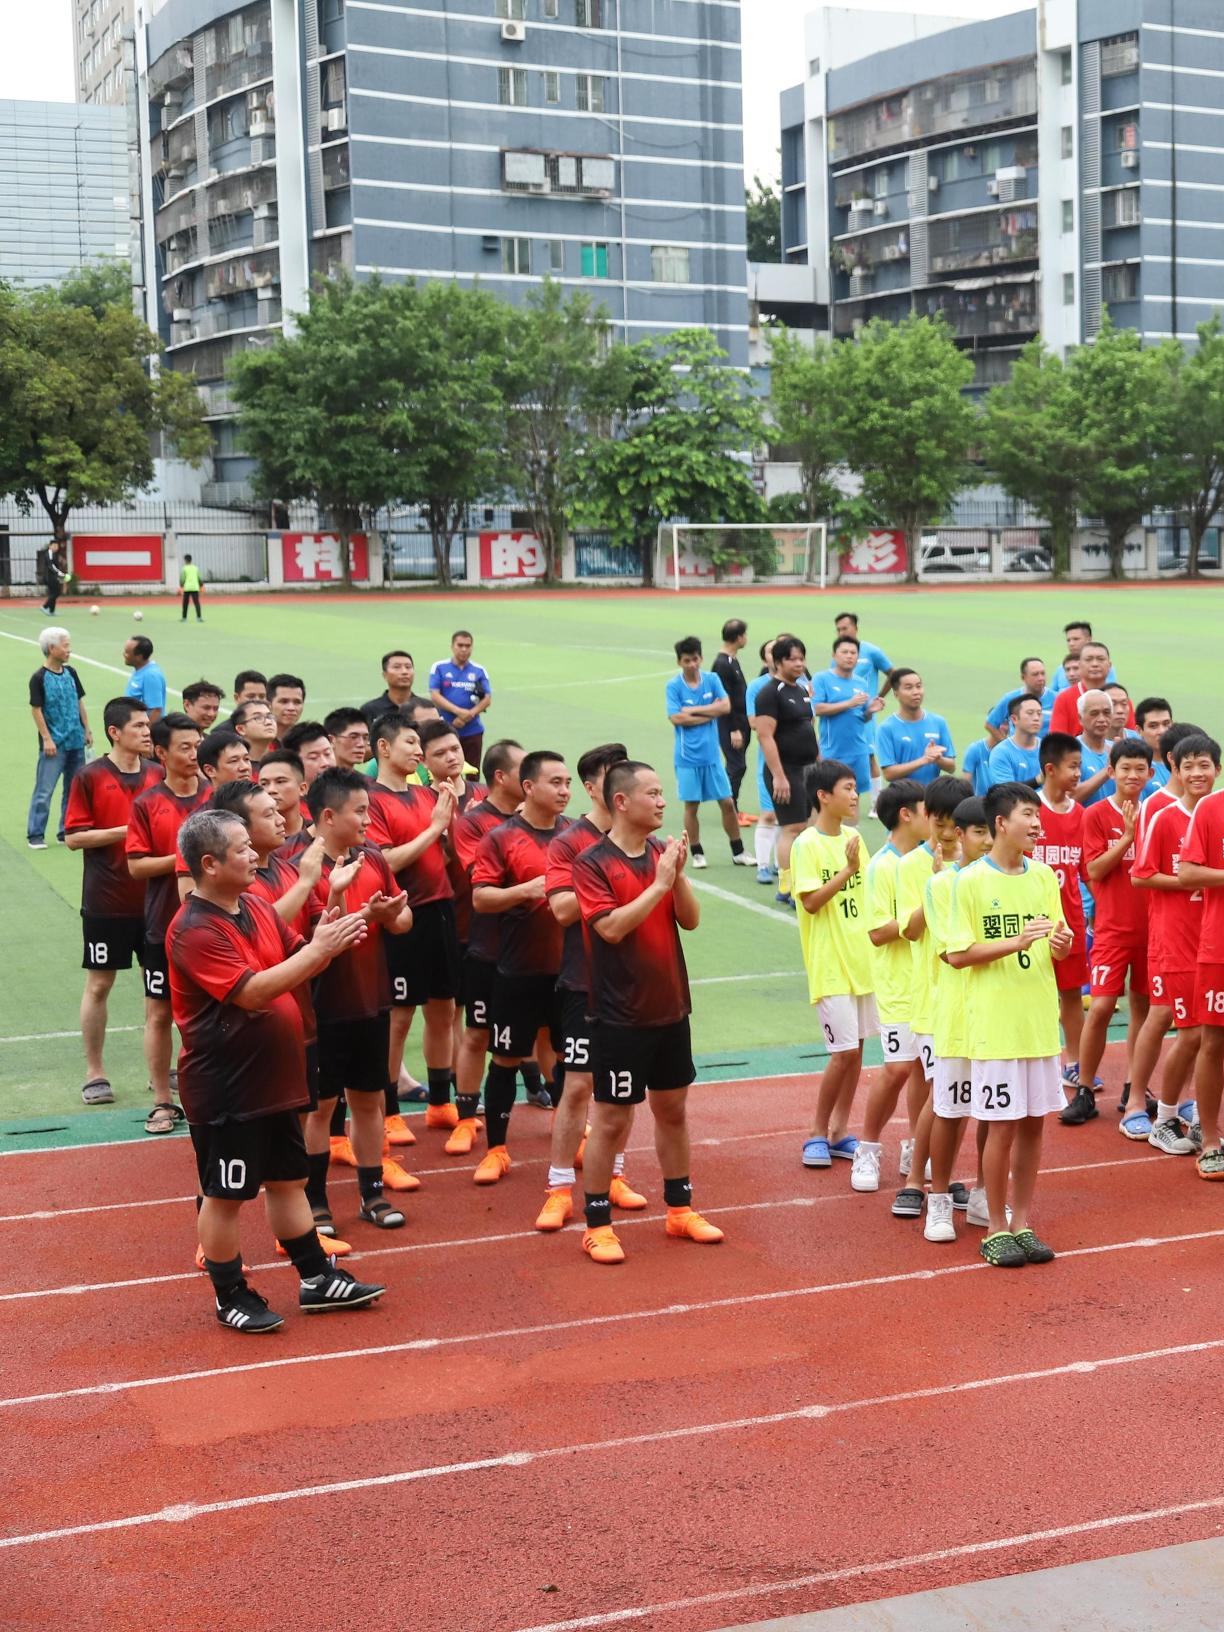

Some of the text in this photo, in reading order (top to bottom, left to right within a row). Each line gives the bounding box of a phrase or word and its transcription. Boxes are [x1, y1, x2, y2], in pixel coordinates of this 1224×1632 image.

[490, 534, 547, 577] 的
[840, 898, 859, 918] 16
[982, 913, 1049, 939] 翠园
[88, 942, 108, 964] 18
[1017, 950, 1031, 970] 6
[145, 969, 165, 995] 12
[1091, 965, 1111, 986] 17
[1152, 975, 1163, 997] 3
[394, 976, 408, 1000] 9
[474, 1000, 487, 1023] 2
[1174, 997, 1187, 1020] 5
[493, 1023, 512, 1050] 14
[824, 1023, 835, 1044] 3
[887, 1031, 900, 1053] 5
[563, 1037, 590, 1065] 35
[922, 1045, 935, 1068] 2
[609, 1070, 632, 1098] 13
[948, 1080, 972, 1104] 18
[982, 1083, 1011, 1109] 25
[219, 1158, 247, 1189] 10
